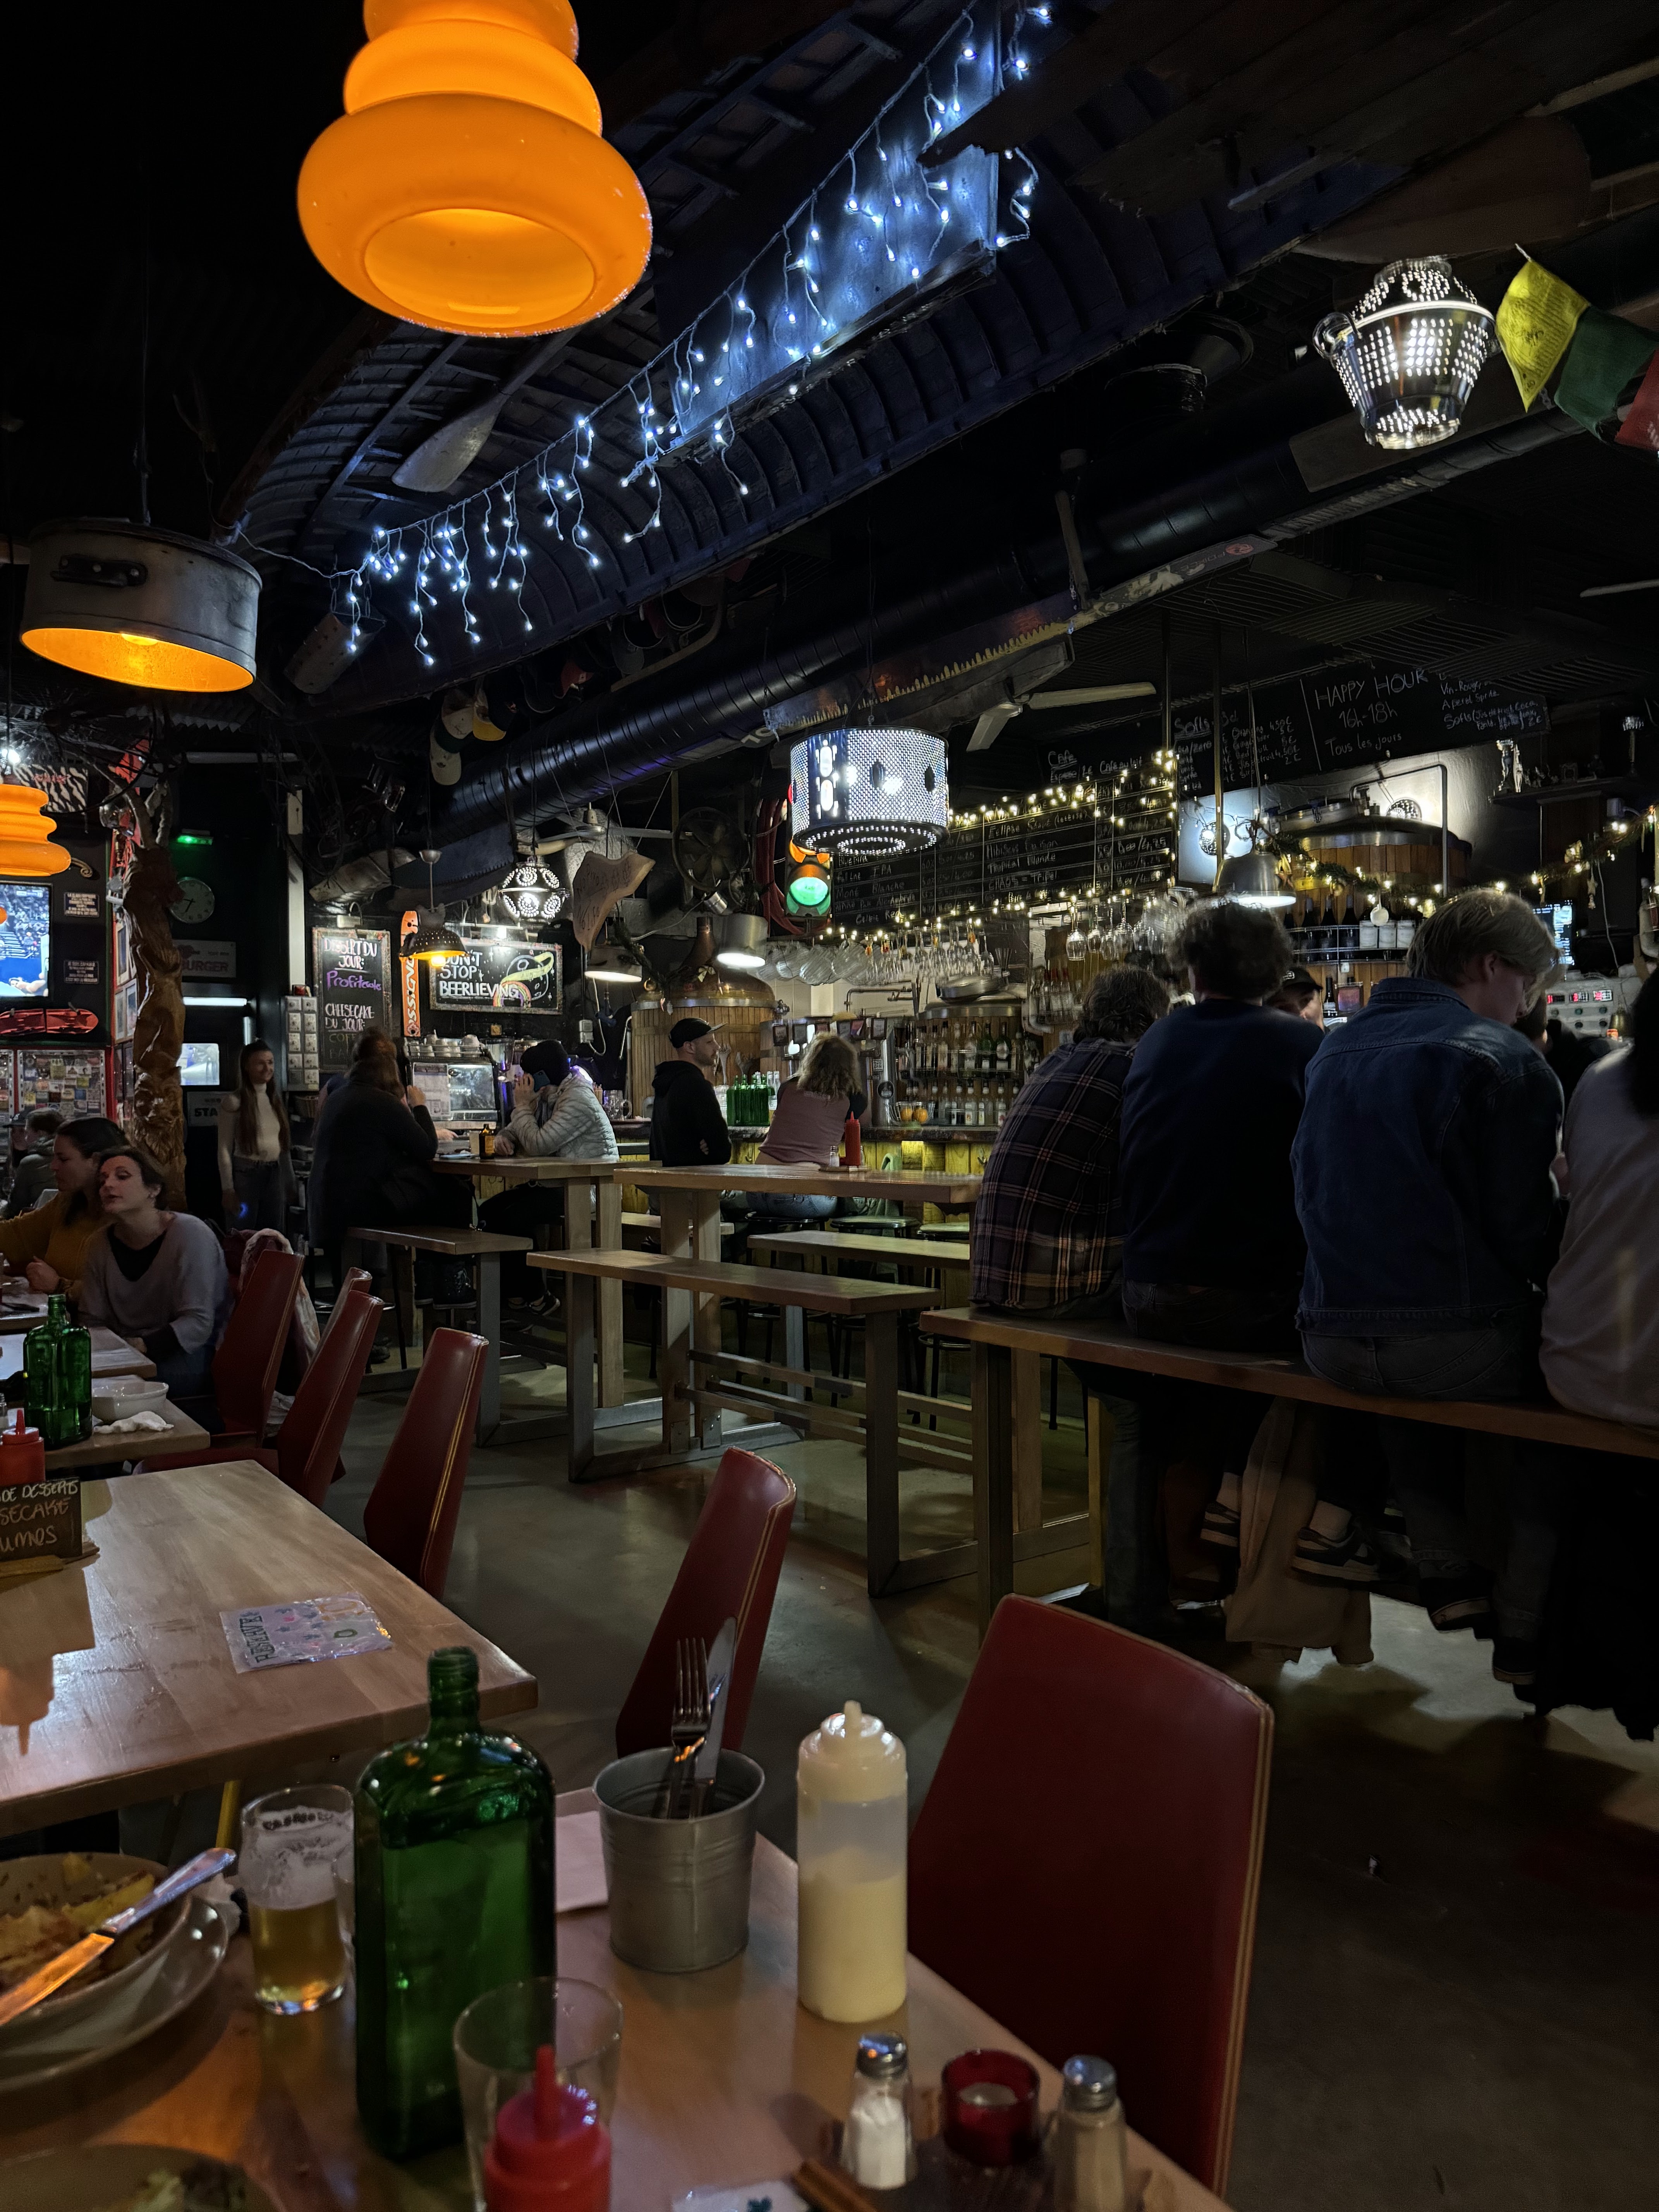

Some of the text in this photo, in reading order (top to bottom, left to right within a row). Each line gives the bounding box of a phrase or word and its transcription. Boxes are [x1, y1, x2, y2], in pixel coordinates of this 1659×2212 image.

[1315, 668, 1429, 710] HAPPY HOUR
[1325, 732, 1402, 756] Tous les jours
[182, 960, 229, 972] URGER
[440, 965, 477, 979] STOP
[439, 980, 520, 999] BEERLIEVING
[325, 1003, 376, 1019] CHEESECAKE
[325, 1017, 338, 1029] DU
[194, 1108, 218, 1117] STA
[0, 1496, 71, 1527] SECAKE
